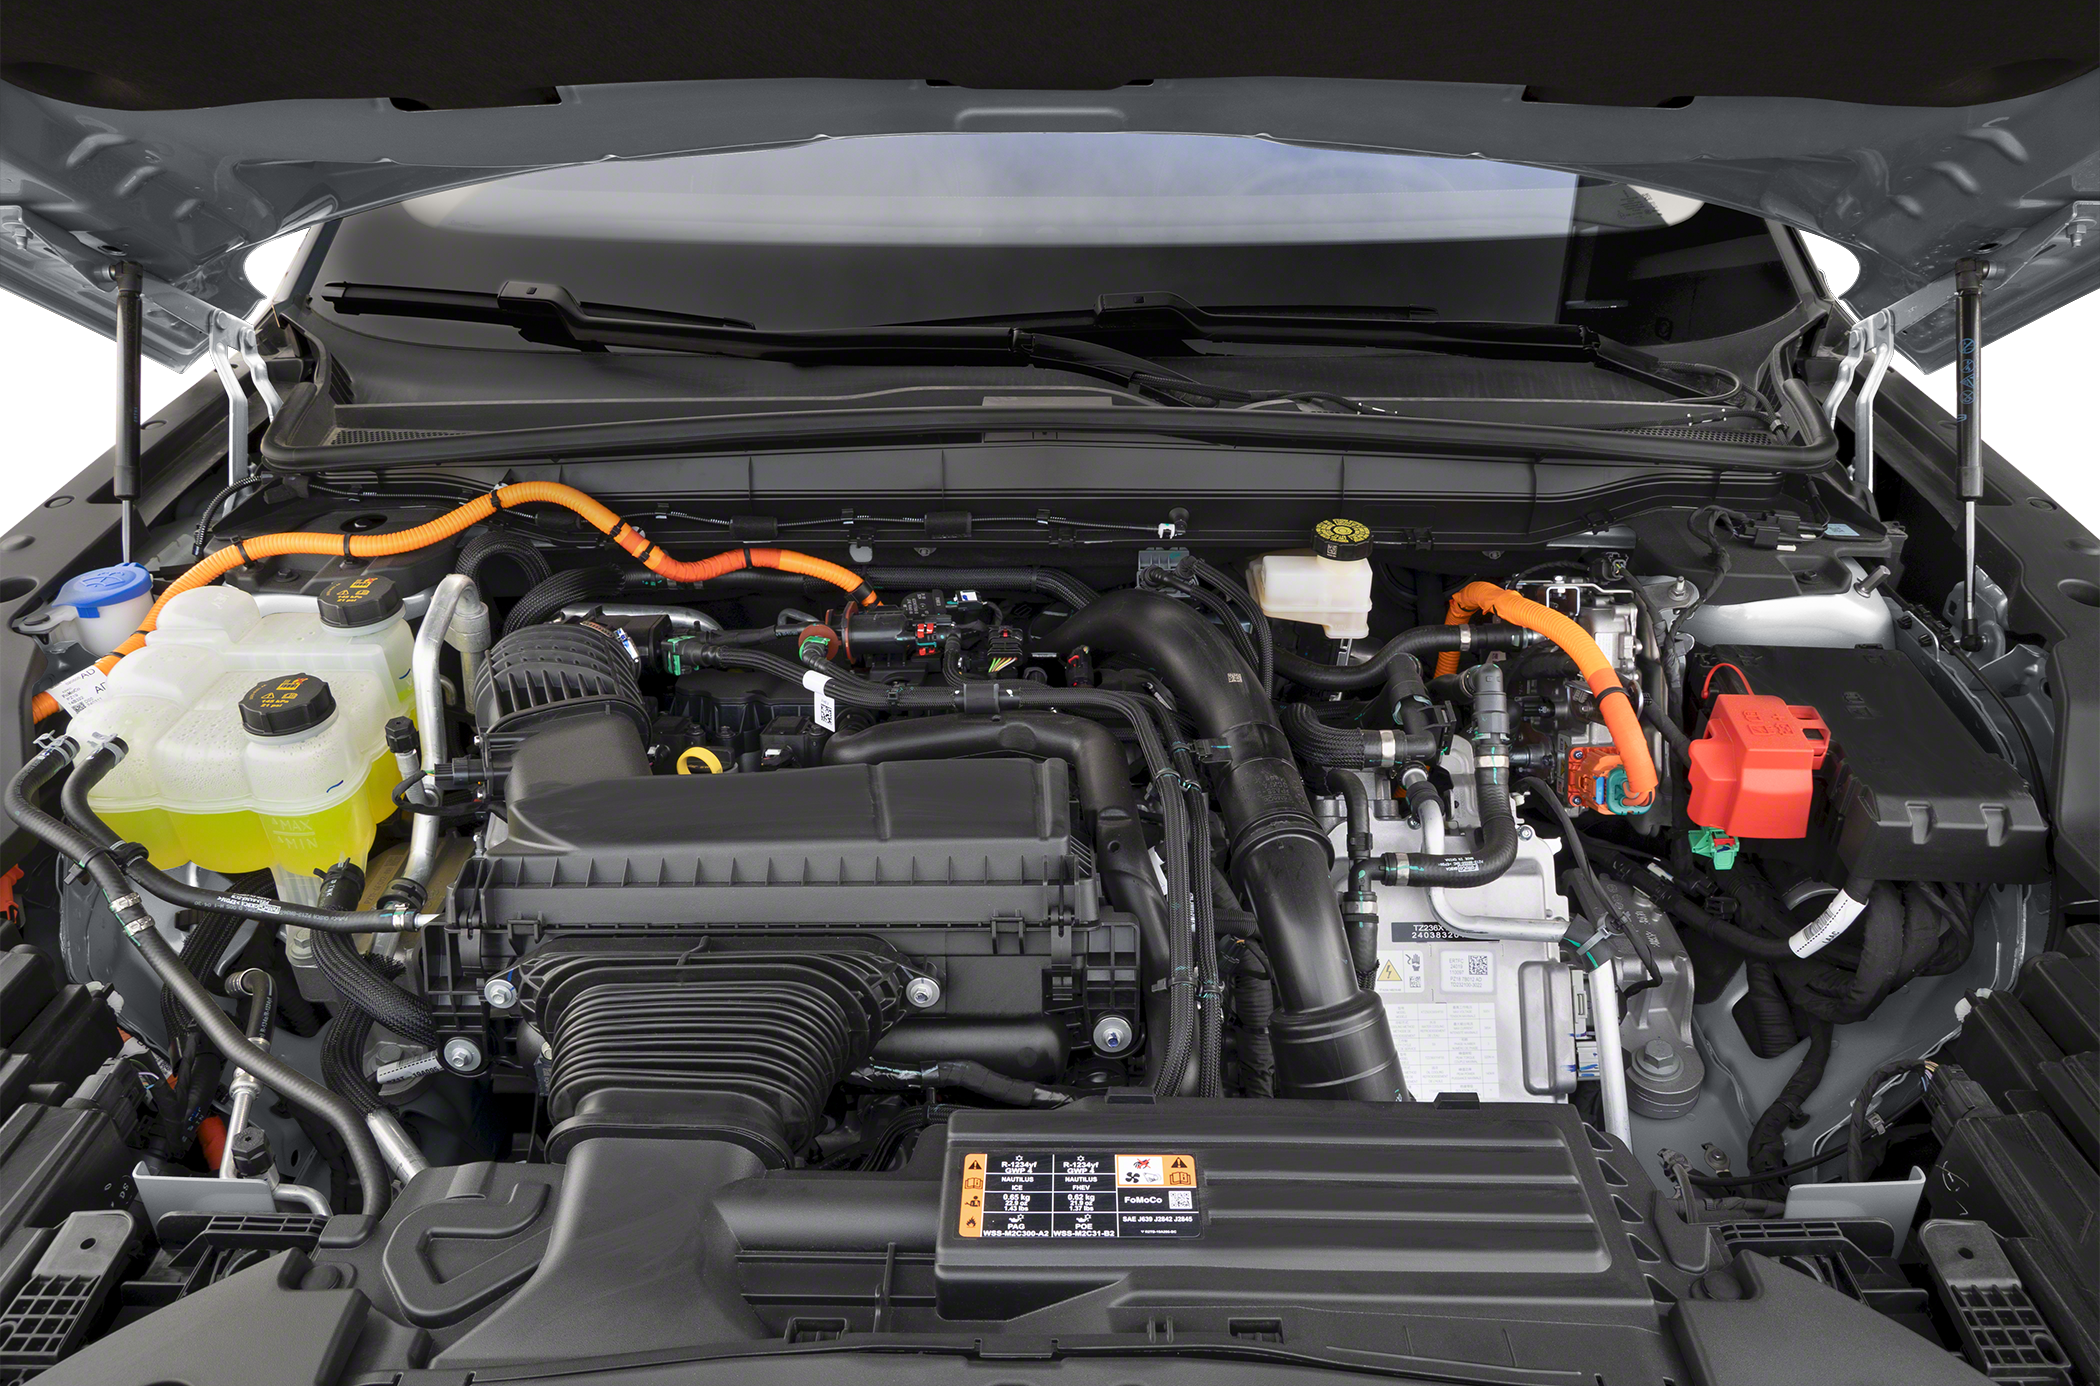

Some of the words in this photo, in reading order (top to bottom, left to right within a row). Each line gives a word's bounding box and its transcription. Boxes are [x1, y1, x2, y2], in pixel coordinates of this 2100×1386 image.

[279, 819, 313, 832] MAX
[285, 837, 319, 850] MIN
[1001, 1161, 1037, 1170] R-1234yf
[1063, 1161, 1099, 1170] R-1234yf
[1020, 1194, 1031, 1202] kg
[1085, 1194, 1095, 1202] kg
[1124, 1196, 1163, 1204] FoMoCo
